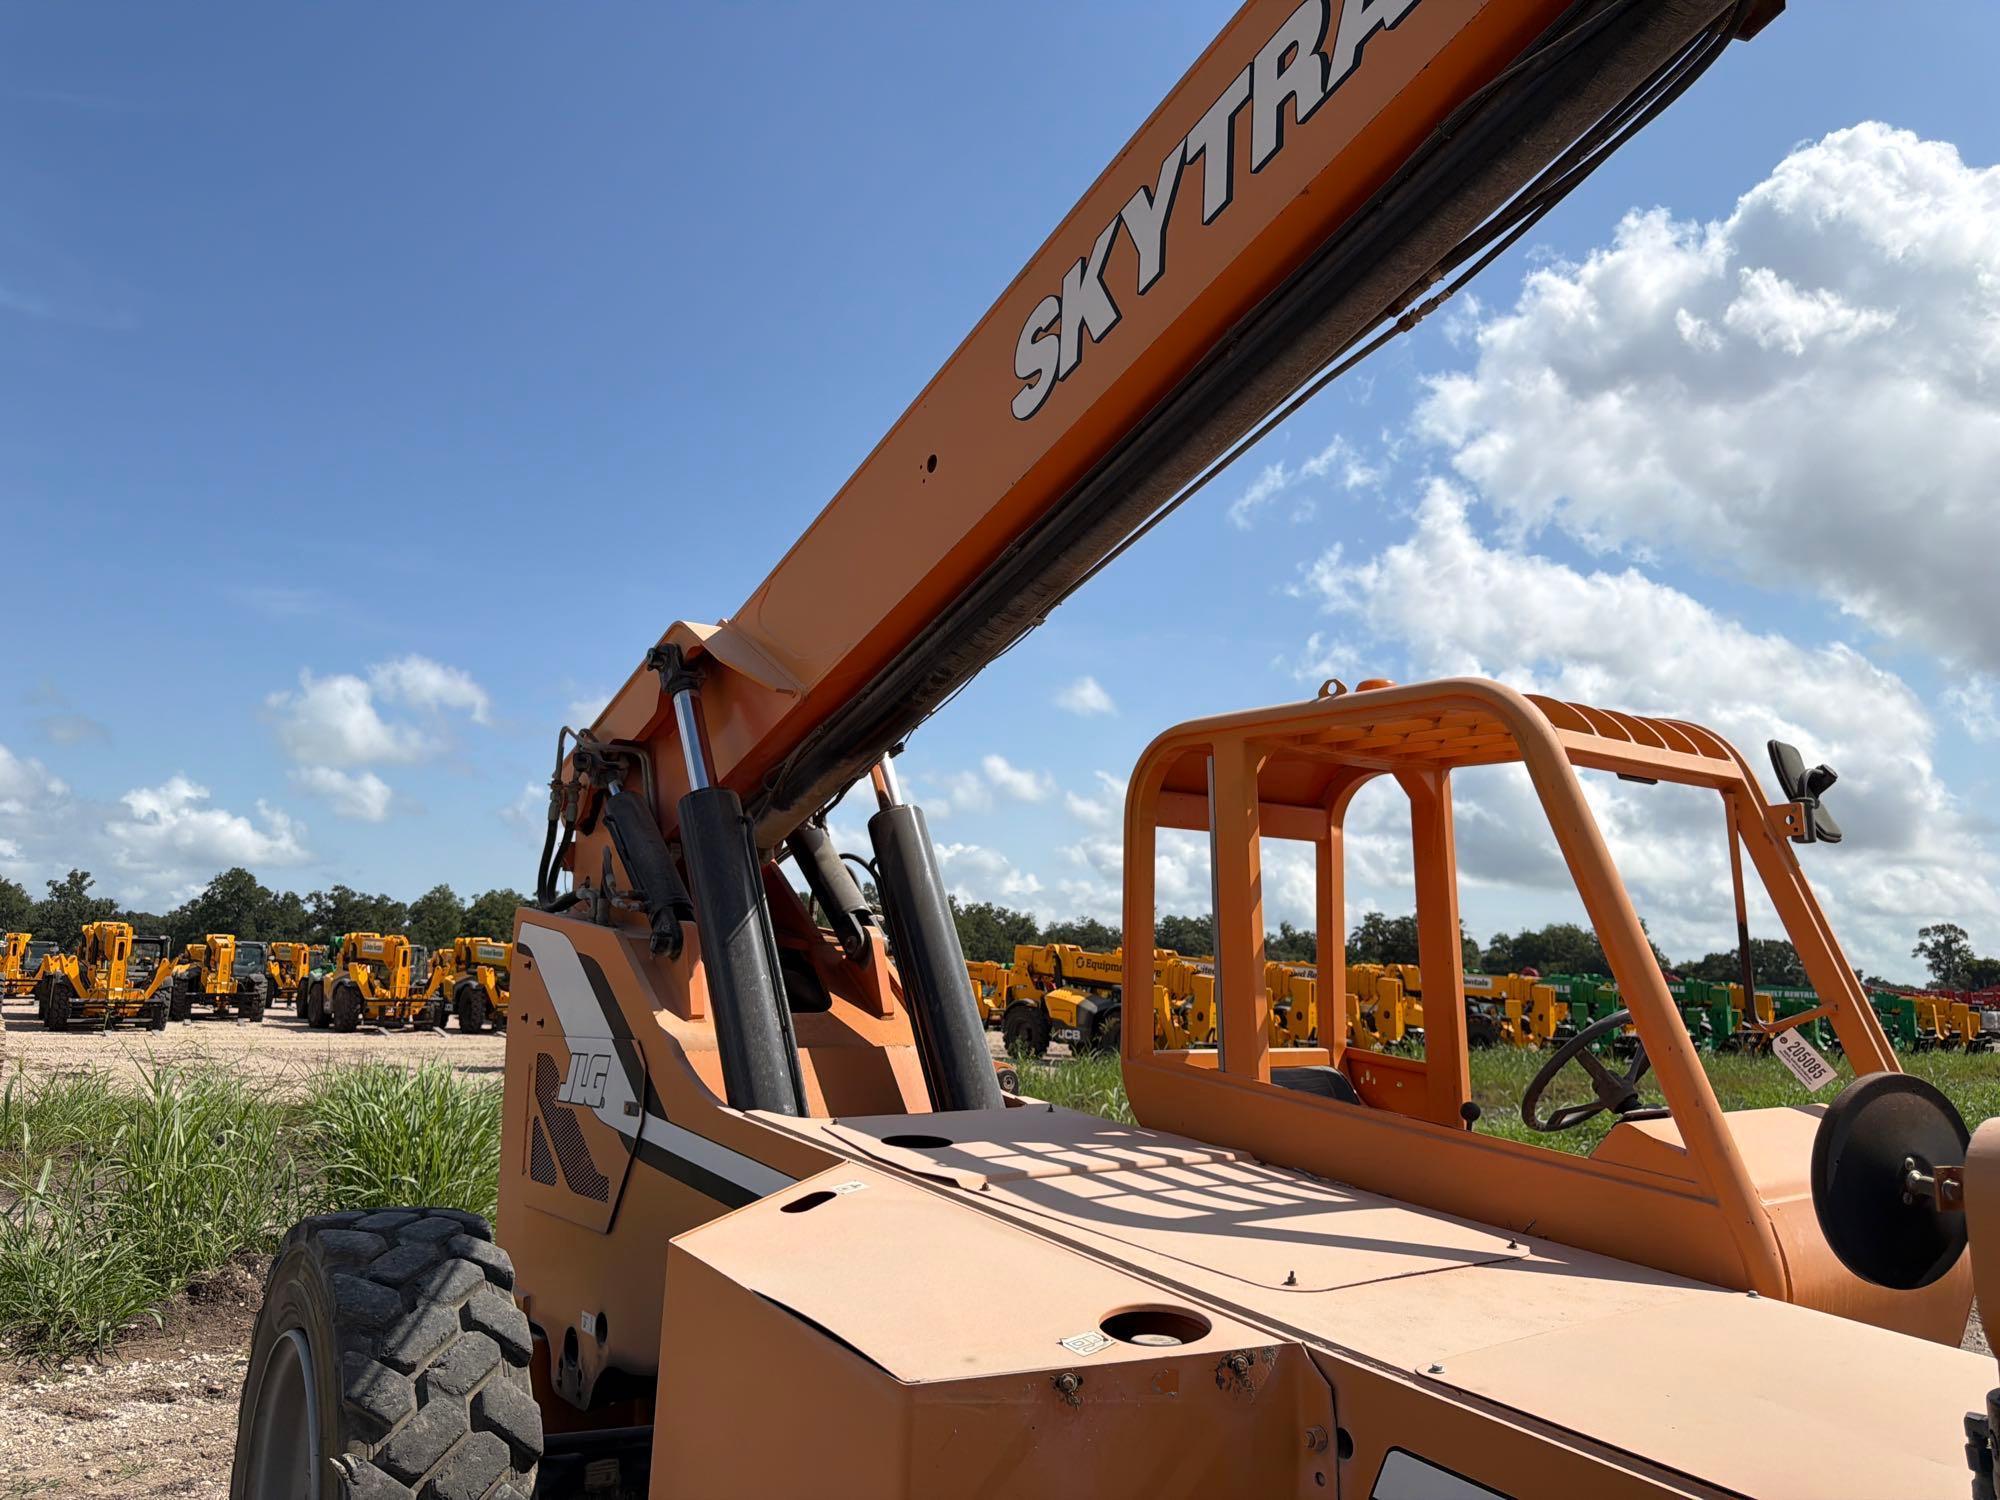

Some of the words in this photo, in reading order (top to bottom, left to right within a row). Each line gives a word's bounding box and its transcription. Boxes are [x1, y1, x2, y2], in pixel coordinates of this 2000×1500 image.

[1058, 1029, 1081, 1040] JCB
[1787, 1041, 1827, 1079] 205085
[557, 1052, 611, 1108] JLG
